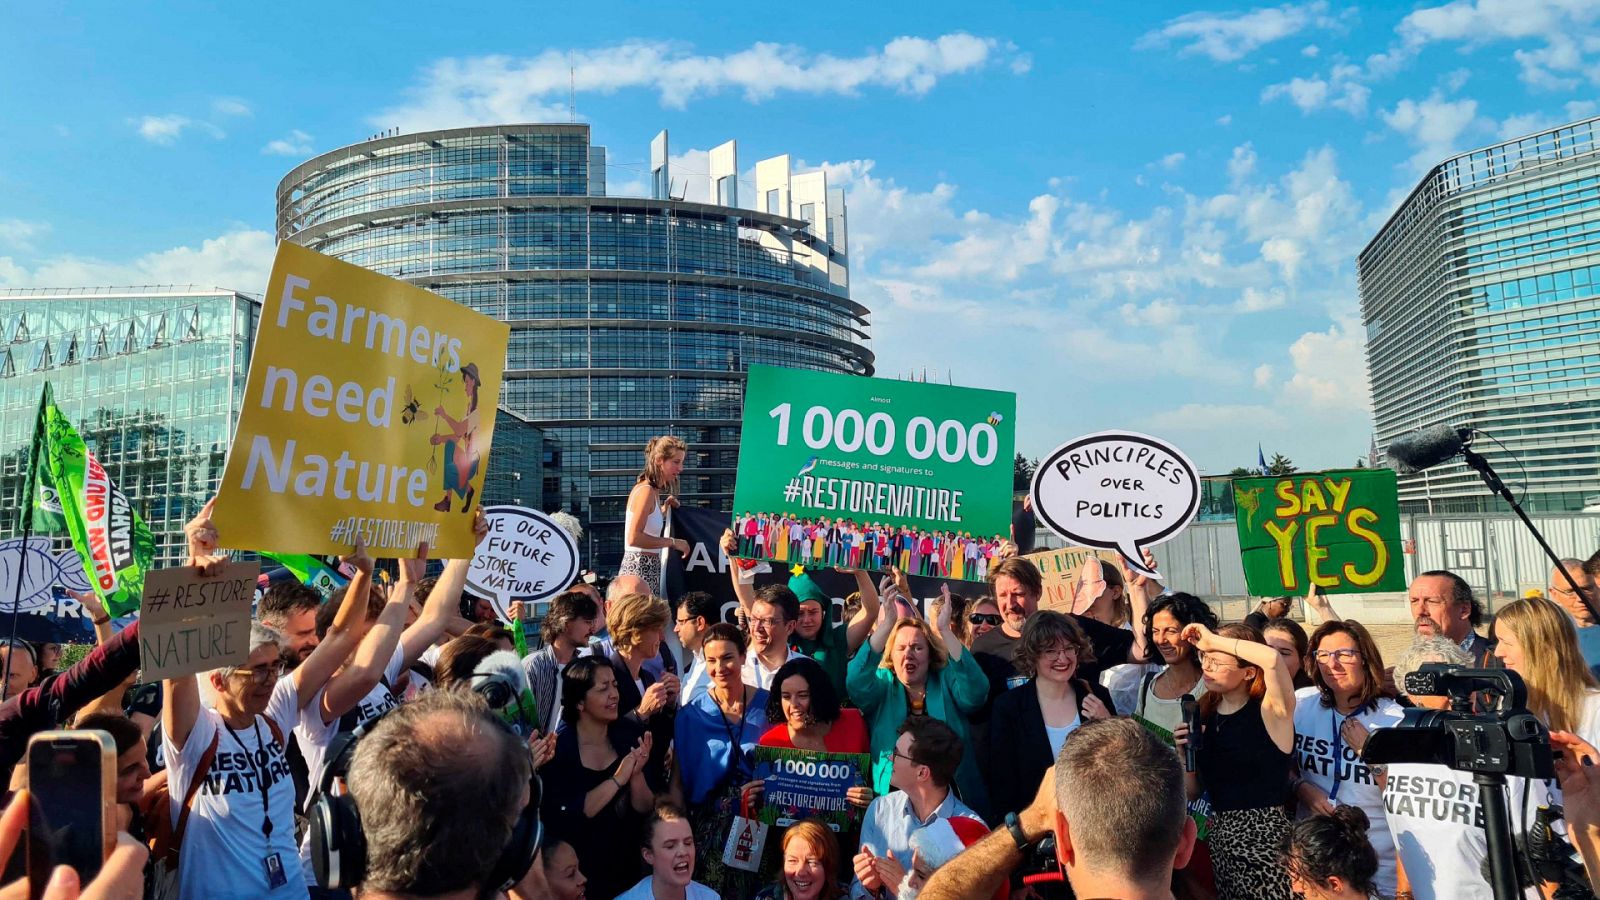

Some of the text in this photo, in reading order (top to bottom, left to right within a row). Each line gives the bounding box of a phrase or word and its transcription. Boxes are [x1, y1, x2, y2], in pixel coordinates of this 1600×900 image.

[277, 273, 463, 374] Farmers
[260, 365, 396, 429] need
[768, 402, 999, 467] 1 000 000
[240, 435, 428, 507] Nature
[819, 458, 934, 476] messages and signatures to
[1056, 446, 1184, 485] PRINCIPLES
[783, 474, 964, 522] #RESTORENATURE
[1100, 478, 1145, 491] OVER
[1275, 478, 1352, 519] SAY
[1076, 500, 1164, 520] POLITICS
[517, 520, 552, 545] OUR
[488, 537, 555, 566] FUTURE
[1263, 507, 1390, 590] YES
[470, 555, 518, 578] STORE
[148, 579, 253, 613] #RESTORE
[482, 573, 545, 594] NATURE
[143, 621, 238, 672] NATURE
[785, 760, 816, 777] 000
[819, 764, 850, 779] 000
[768, 790, 847, 811] #RESTORENATURE
[1387, 776, 1482, 804] RESTOR
